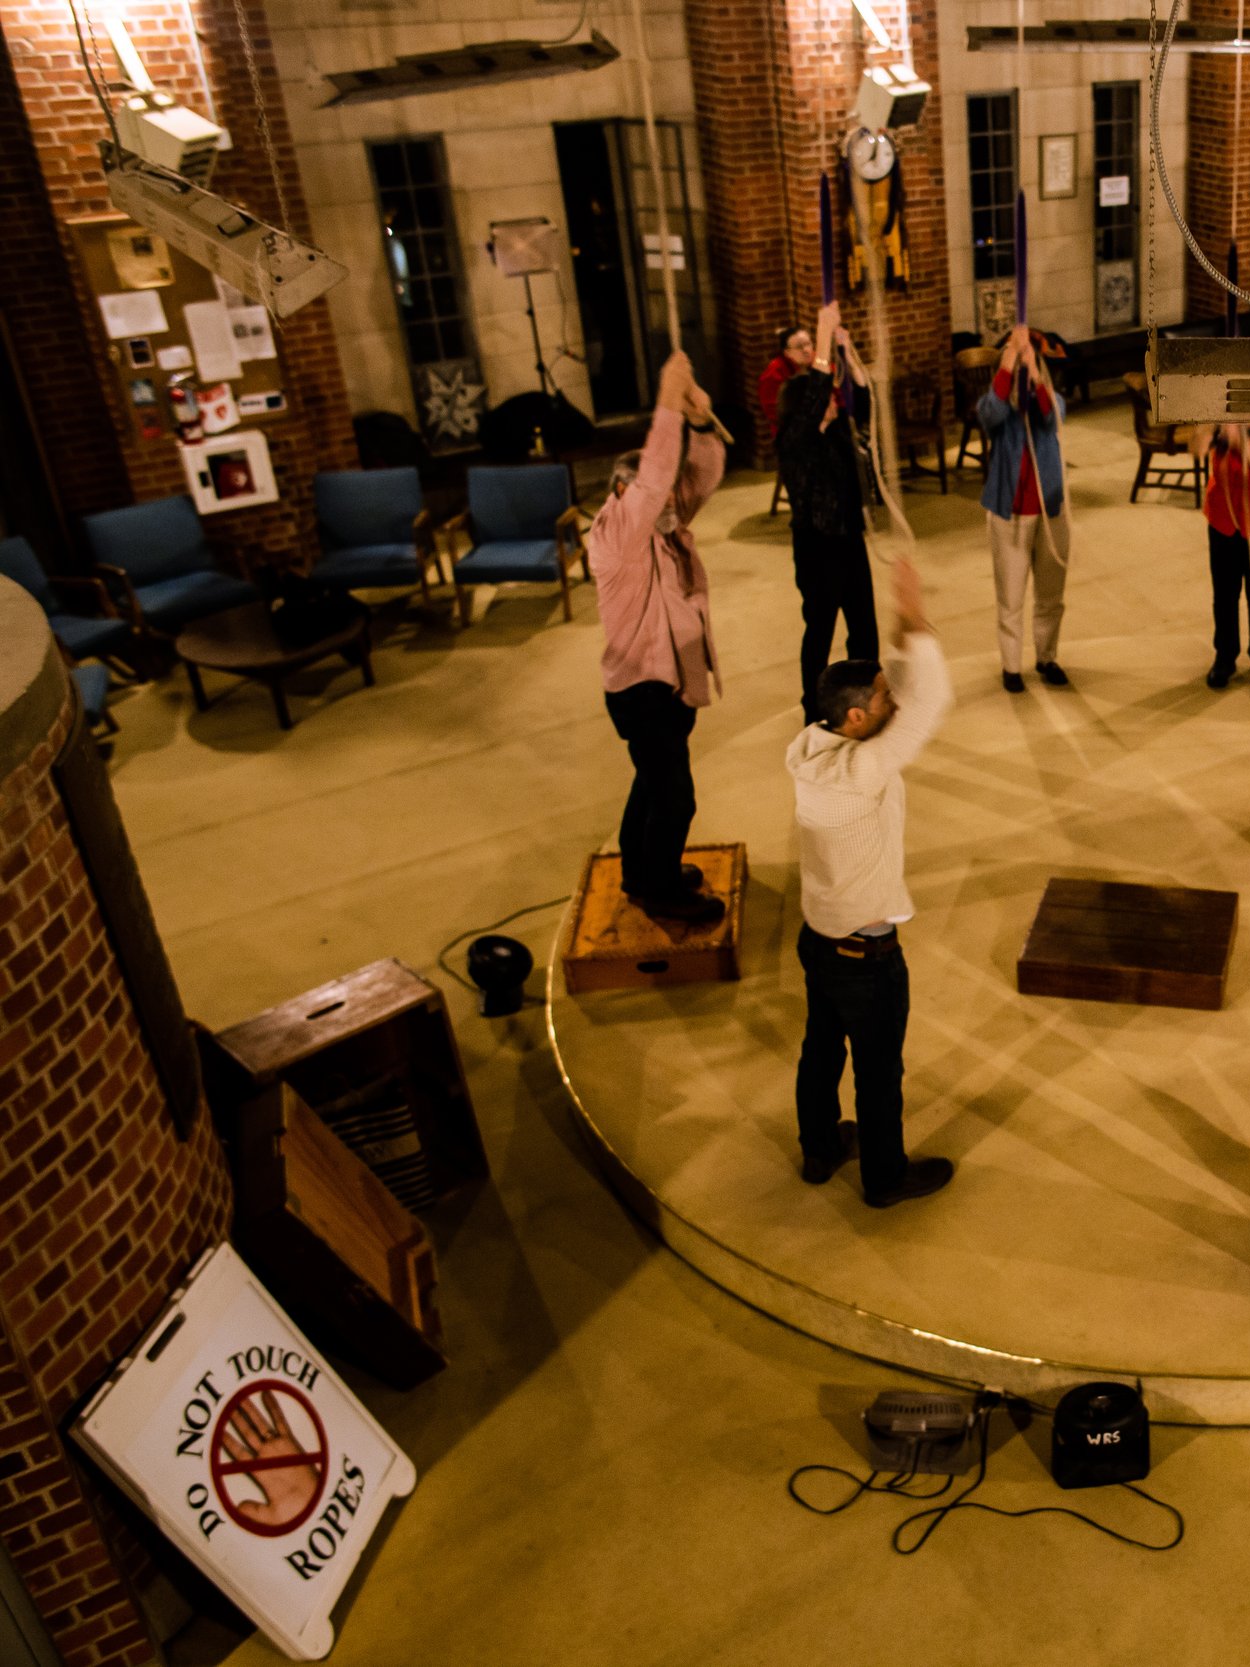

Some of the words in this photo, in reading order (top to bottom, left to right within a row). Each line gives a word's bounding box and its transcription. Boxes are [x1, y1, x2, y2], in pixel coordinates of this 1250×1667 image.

[227, 1345, 321, 1391] TOUCH
[176, 1370, 224, 1459] NOT
[1086, 1430, 1121, 1445] WRS
[187, 1483, 225, 1542] DO
[284, 1454, 366, 1580] ROPES
